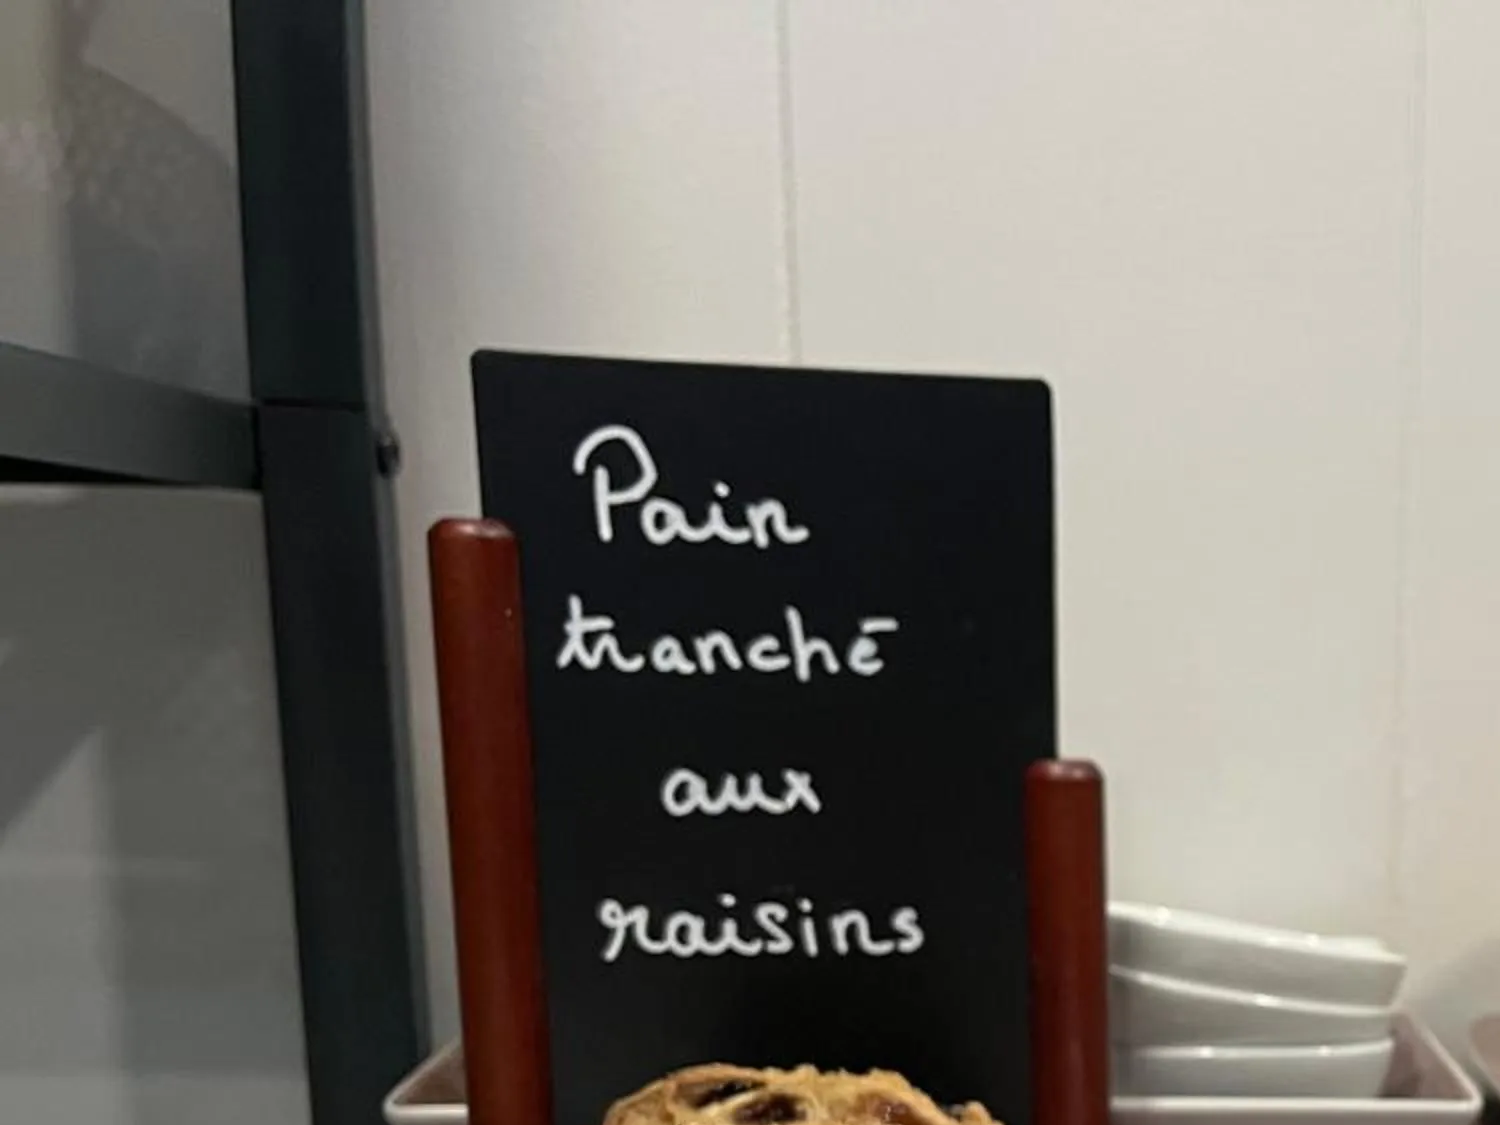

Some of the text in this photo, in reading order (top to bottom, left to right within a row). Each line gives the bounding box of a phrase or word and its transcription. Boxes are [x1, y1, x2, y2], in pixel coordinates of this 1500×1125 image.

[572, 425, 809, 549] Pain
[556, 594, 899, 683] tranché
[660, 768, 822, 816] aux
[596, 893, 925, 962] raisins
